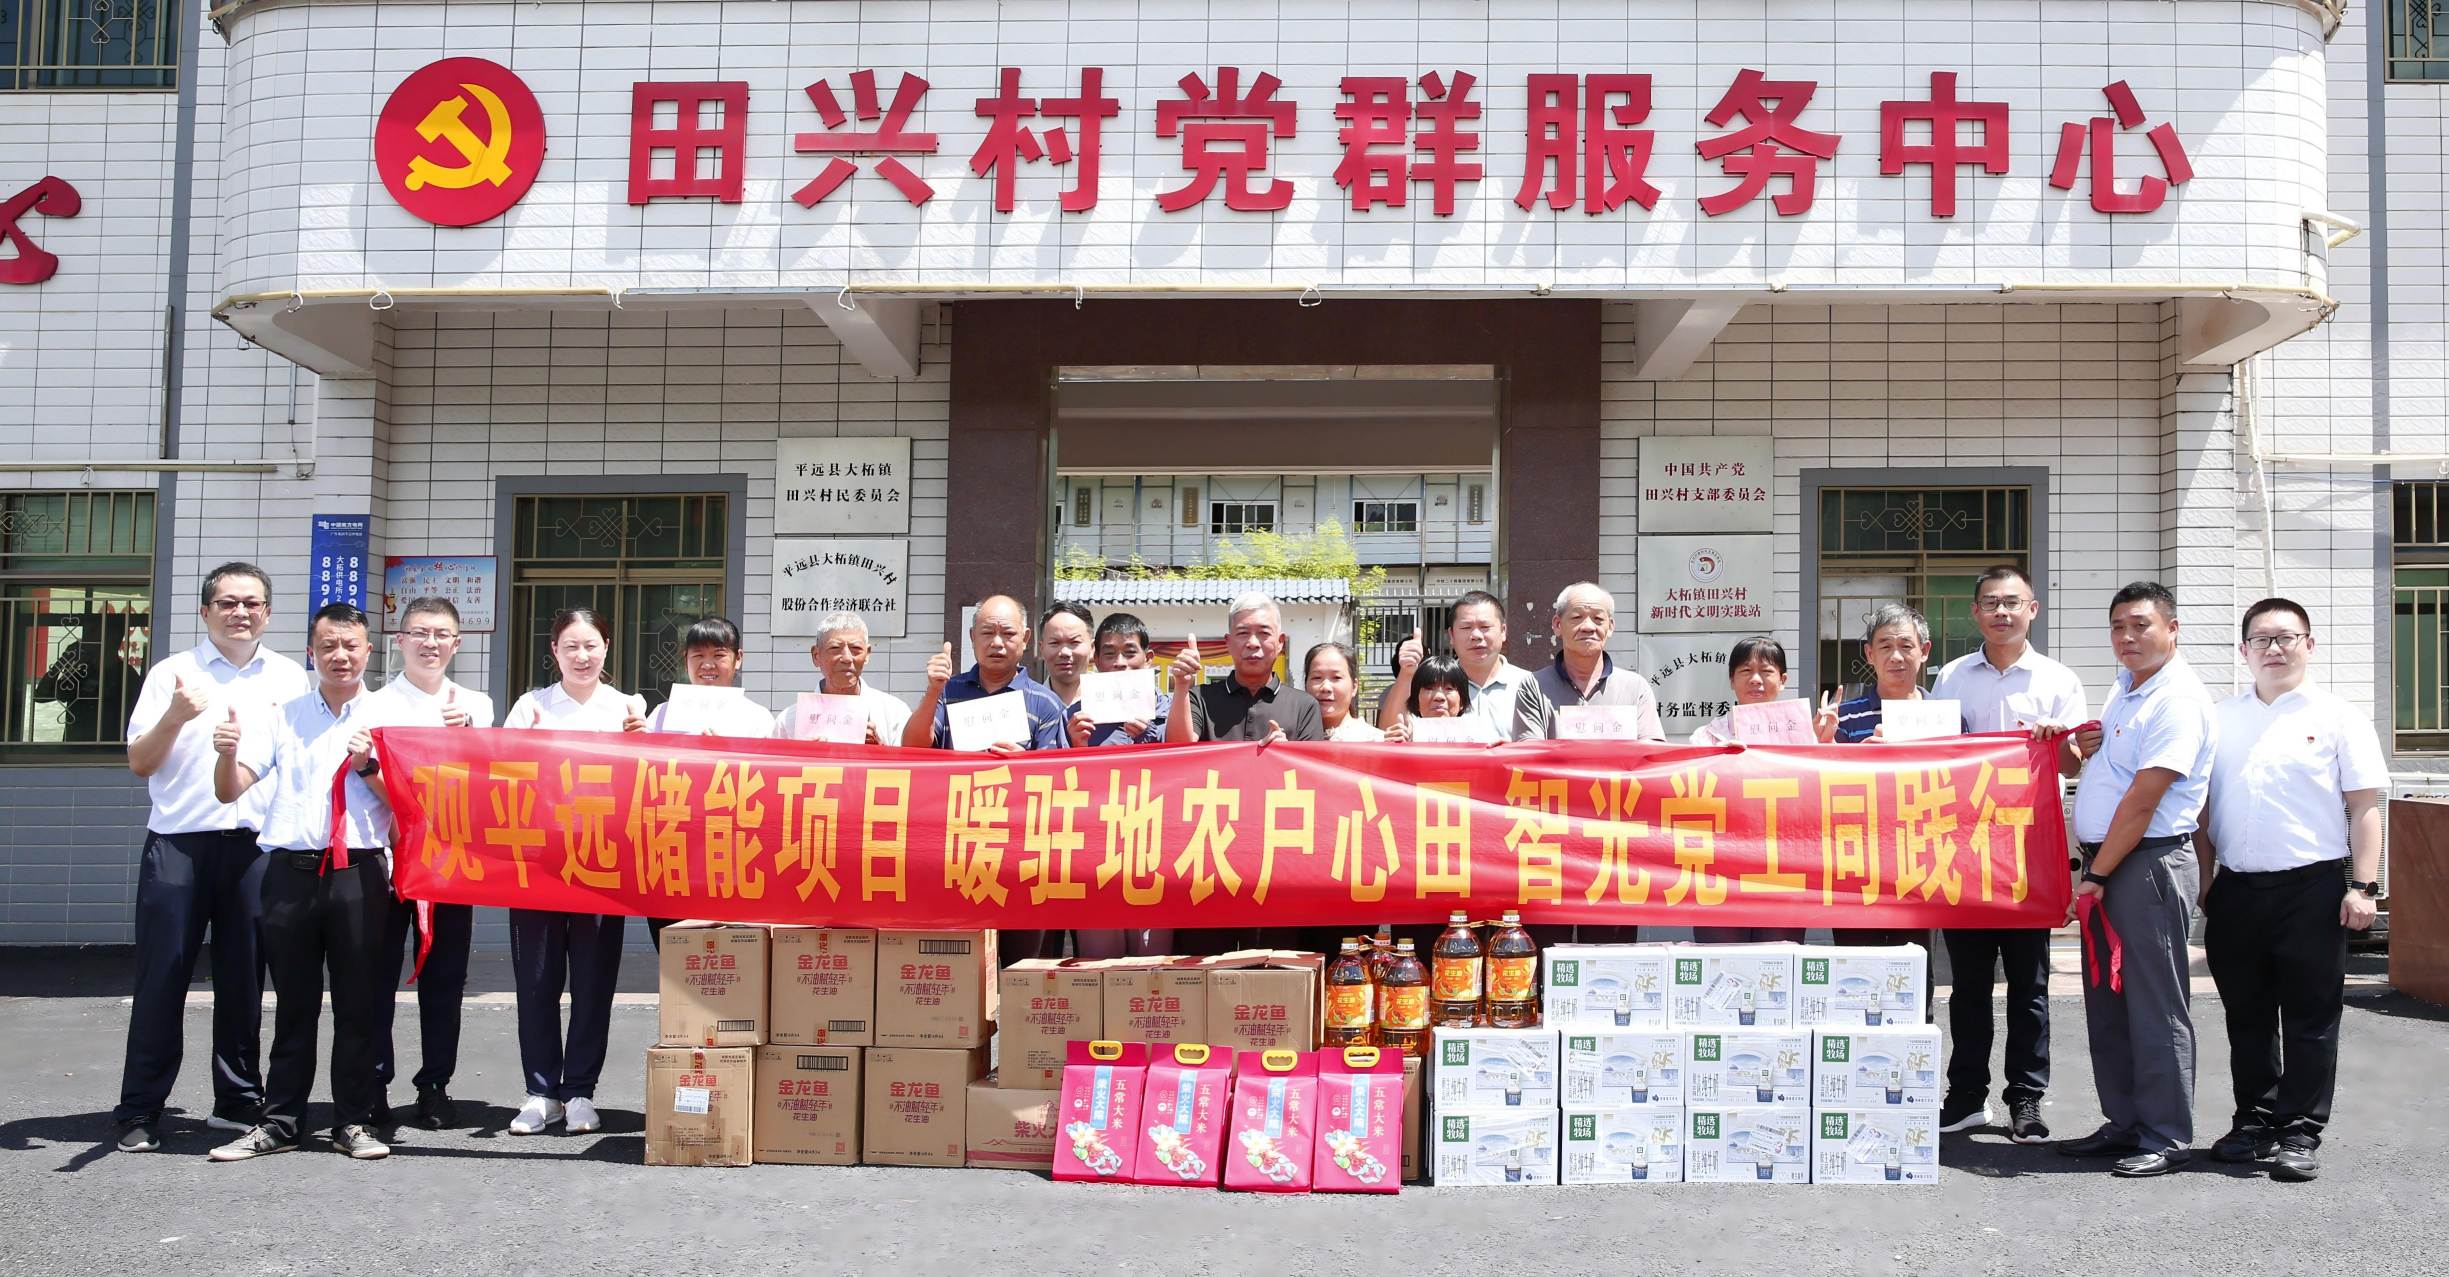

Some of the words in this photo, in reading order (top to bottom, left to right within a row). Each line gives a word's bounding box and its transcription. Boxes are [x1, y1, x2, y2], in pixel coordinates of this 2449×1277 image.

[627, 66, 2195, 217] 田兴村党群服务中心
[794, 462, 892, 477] 平远县大柘镇
[1664, 462, 1745, 477] 中国共产党
[786, 488, 900, 502] 田兴村民委员会
[1645, 487, 1766, 502] 田兴村支部委员会
[783, 552, 897, 586] 平远县大柘镇田兴村
[1665, 587, 1748, 602] 大柘镇田兴村
[781, 597, 897, 612] 股份合作经济联合社
[1650, 604, 1761, 619] 新时代文明实践站
[413, 758, 912, 903] 观平远储能项目
[944, 764, 1472, 907] 暖驻地农户心田
[1503, 759, 2035, 906] 智光党工同践行
[685, 954, 736, 970] 金龙鱼
[797, 954, 849, 970] 金龙鱼
[1681, 961, 1698, 972] 精选
[1806, 961, 1824, 971] 精选
[900, 964, 951, 980] 金龙鱼
[1556, 963, 1574, 973] 精选
[1556, 973, 1574, 984] 牧场
[1680, 972, 1698, 982] 牧场
[1806, 971, 1824, 982] 牧场
[700, 987, 726, 996] 花生油
[812, 987, 838, 996] 花生油
[915, 997, 941, 1006] 花生油
[1031, 997, 1069, 1010] 金龙鱼
[1129, 997, 1181, 1013] 金龙鱼
[1234, 1004, 1287, 1020] 金龙鱼
[1041, 1026, 1065, 1035] 花生油
[1145, 1030, 1171, 1039] 花生油
[1249, 1037, 1276, 1046] 花生油
[1574, 1039, 1592, 1050] 精选
[1699, 1037, 1716, 1048] 精选
[1827, 1038, 1845, 1049] 精选
[1448, 1042, 1465, 1053] 精选
[1698, 1048, 1716, 1058] 牧场
[1447, 1053, 1465, 1063] 牧场
[1826, 1049, 1845, 1059] 牧场
[679, 1075, 717, 1087] 金龙鱼
[778, 1079, 829, 1096] 金龙鱼
[890, 1081, 940, 1098] 金龙鱼
[1111, 1079, 1127, 1129] 五常大米
[1196, 1084, 1211, 1133] 五常大米
[792, 1112, 818, 1121] 花生油
[1287, 1088, 1301, 1137] 五常大米
[1373, 1087, 1385, 1136] 五常大米
[904, 1114, 930, 1123] 花生油
[1448, 1119, 1465, 1129] 精选
[1574, 1117, 1591, 1128] 精选
[1698, 1115, 1715, 1126] 精选
[1826, 1115, 1843, 1126] 精选
[1447, 1129, 1465, 1140] 牧场
[1573, 1128, 1591, 1138] 牧场
[1697, 1126, 1715, 1136] 牧场
[1825, 1126, 1843, 1136] 牧场
